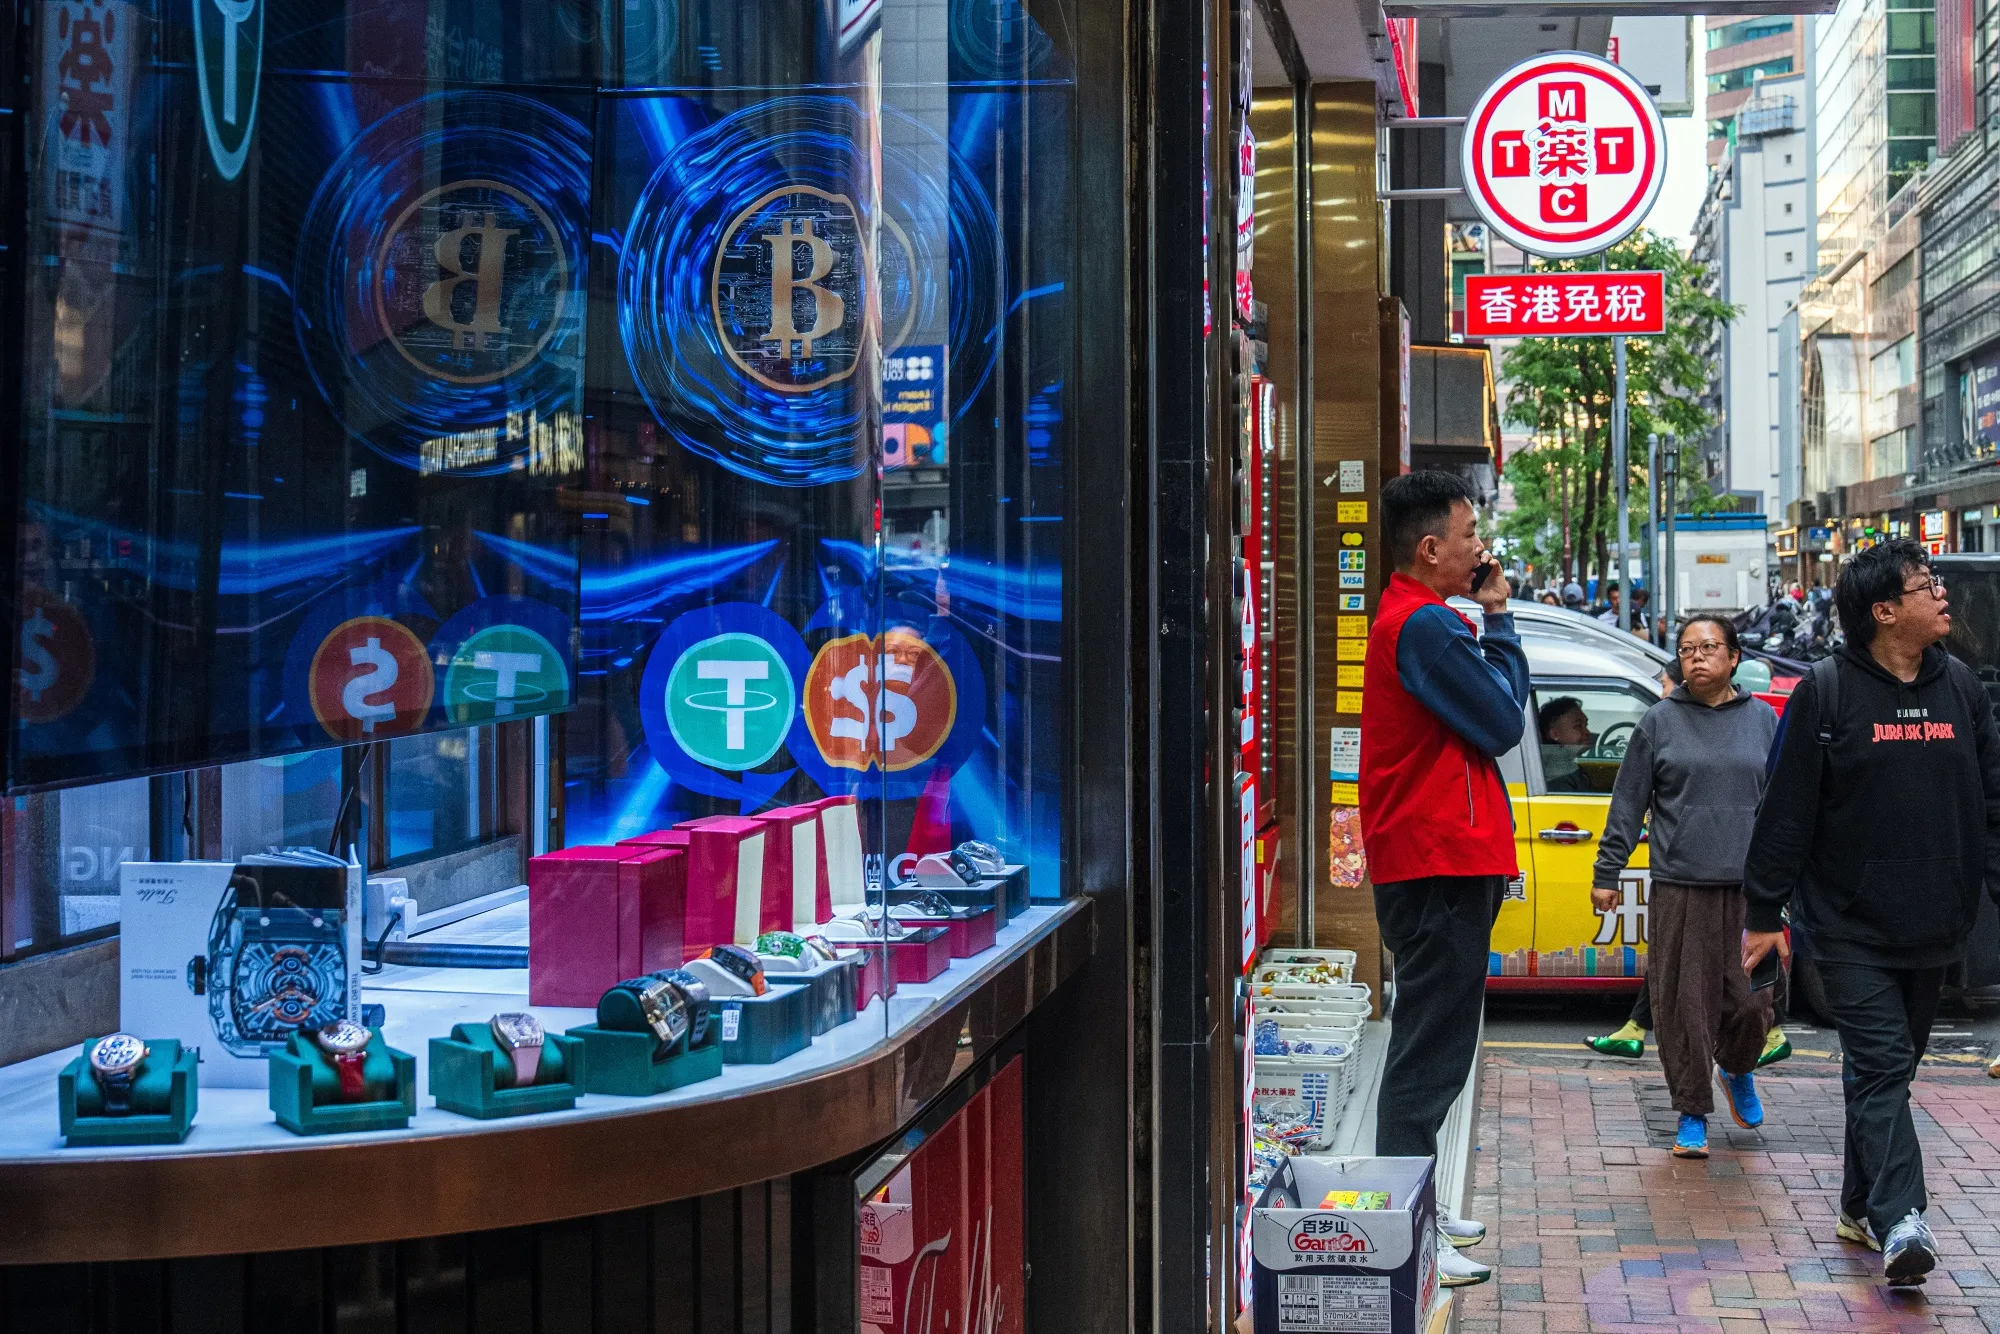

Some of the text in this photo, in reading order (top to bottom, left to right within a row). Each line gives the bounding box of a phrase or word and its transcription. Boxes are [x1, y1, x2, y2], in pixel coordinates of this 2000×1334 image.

[1548, 90, 1577, 118] M
[1499, 140, 1521, 168] T
[1601, 137, 1624, 165] T
[1551, 188, 1576, 217] C
[1480, 284, 1647, 324] 香港免稅
[1342, 576, 1363, 585] VISA
[1924, 721, 1955, 742] PARK
[1302, 1220, 1349, 1234] 百岁山
[1324, 1312, 1358, 1320] 570mlx24
